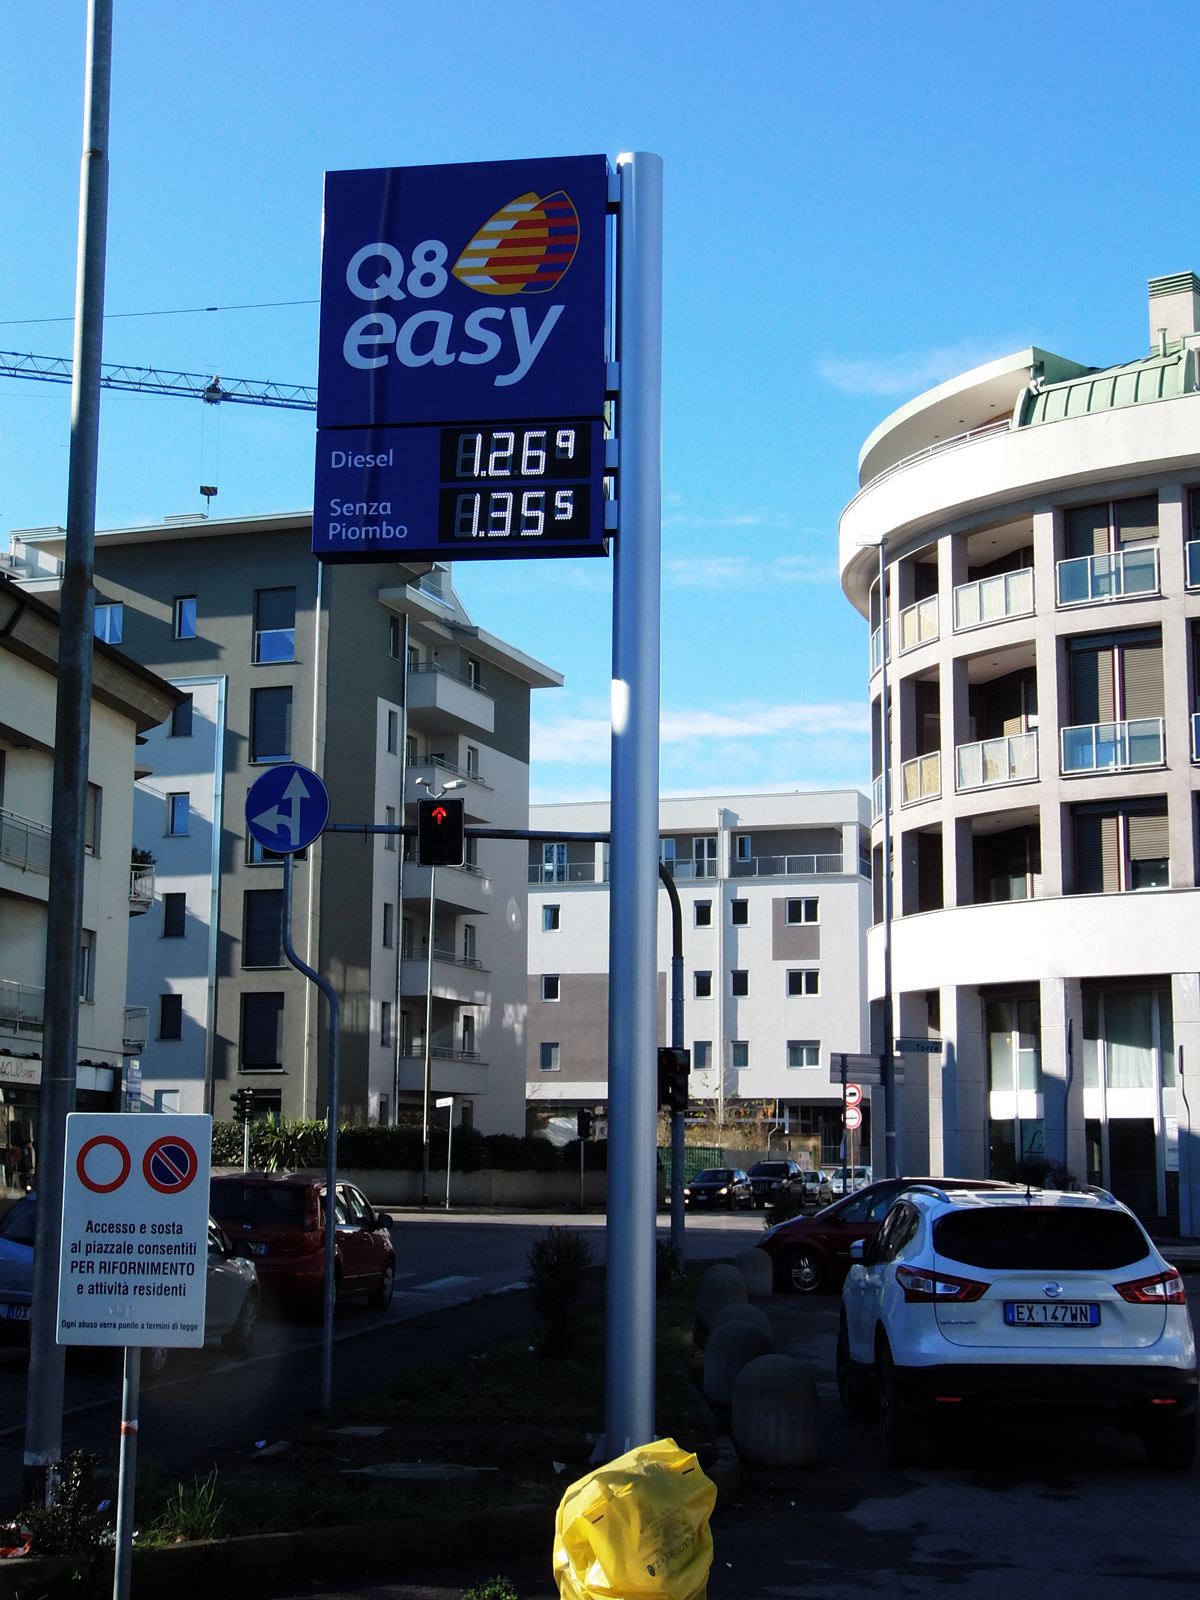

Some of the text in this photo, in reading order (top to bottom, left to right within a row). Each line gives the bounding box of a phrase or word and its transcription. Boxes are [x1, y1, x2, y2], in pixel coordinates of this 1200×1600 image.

[346, 240, 448, 301] Q8
[343, 305, 565, 386] easy
[331, 449, 394, 469] Diesel
[330, 499, 391, 517] Senza
[328, 522, 408, 540] Piombo
[916, 1044, 939, 1052] Torre
[85, 1220, 183, 1235] Accesso e sosta
[70, 1240, 197, 1256] al piazzale consentiti
[70, 1260, 195, 1276] PER RIFORNIMENTO
[77, 1281, 186, 1296] e attività residenti
[1016, 1305, 1034, 1321] EX
[1042, 1305, 1088, 1322] 147WN
[61, 1320, 76, 1329] Ogni
[78, 1321, 98, 1329] abuso
[118, 1321, 139, 1330] punito
[146, 1322, 170, 1330] termini
[171, 1322, 178, 1330] di
[179, 1322, 199, 1332] legge
